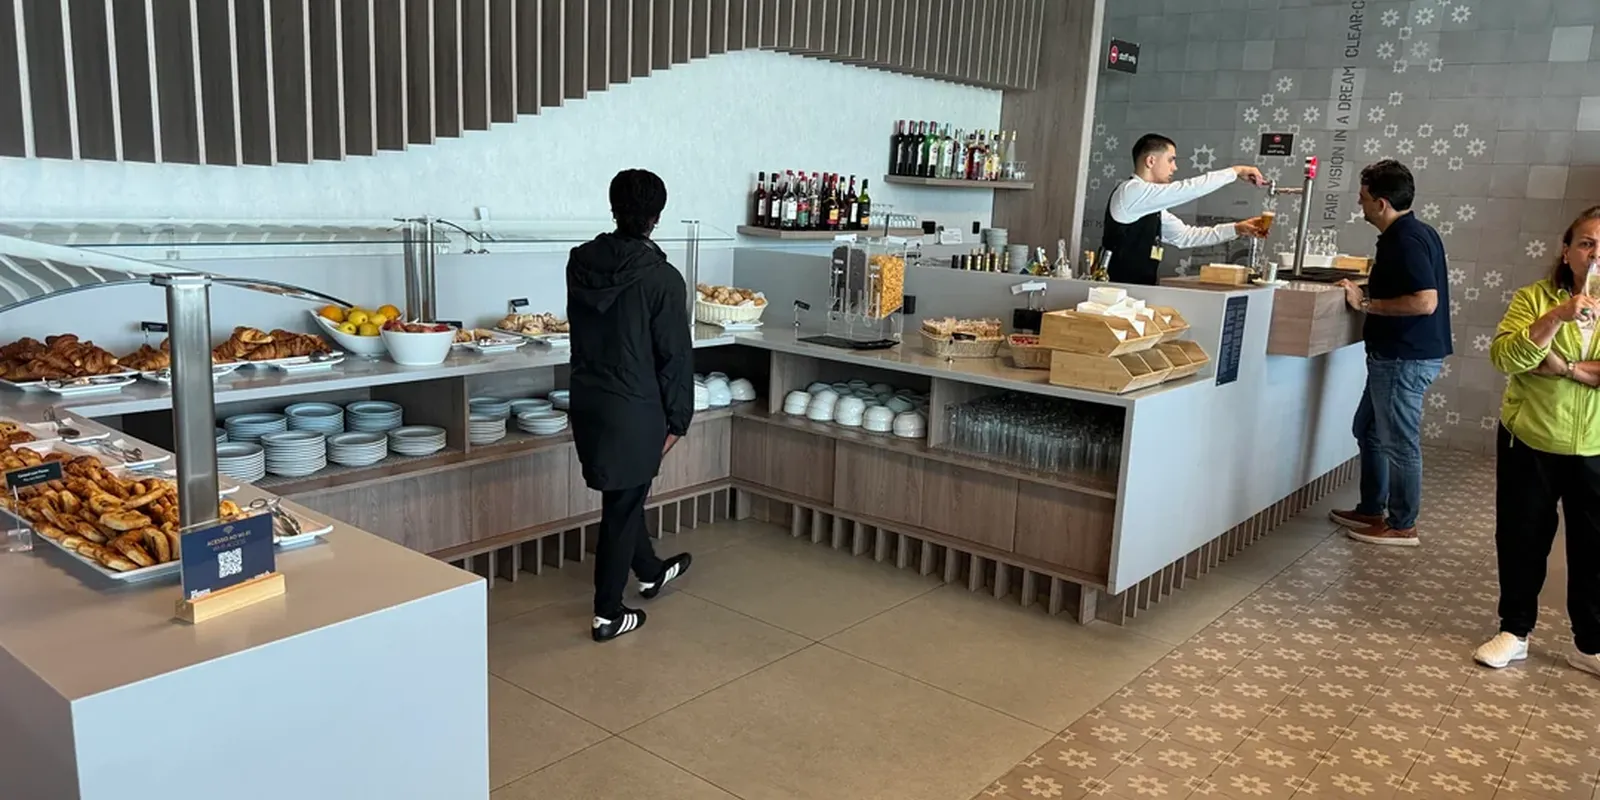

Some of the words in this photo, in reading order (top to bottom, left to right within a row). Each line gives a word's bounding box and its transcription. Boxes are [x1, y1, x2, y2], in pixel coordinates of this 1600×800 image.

[1337, 66, 1357, 111] DREAM
[1336, 115, 1349, 125] A
[1333, 130, 1347, 142] IN
[1327, 147, 1346, 189] VISION
[1323, 193, 1339, 221] FAIR
[206, 536, 229, 547] ACESSO
